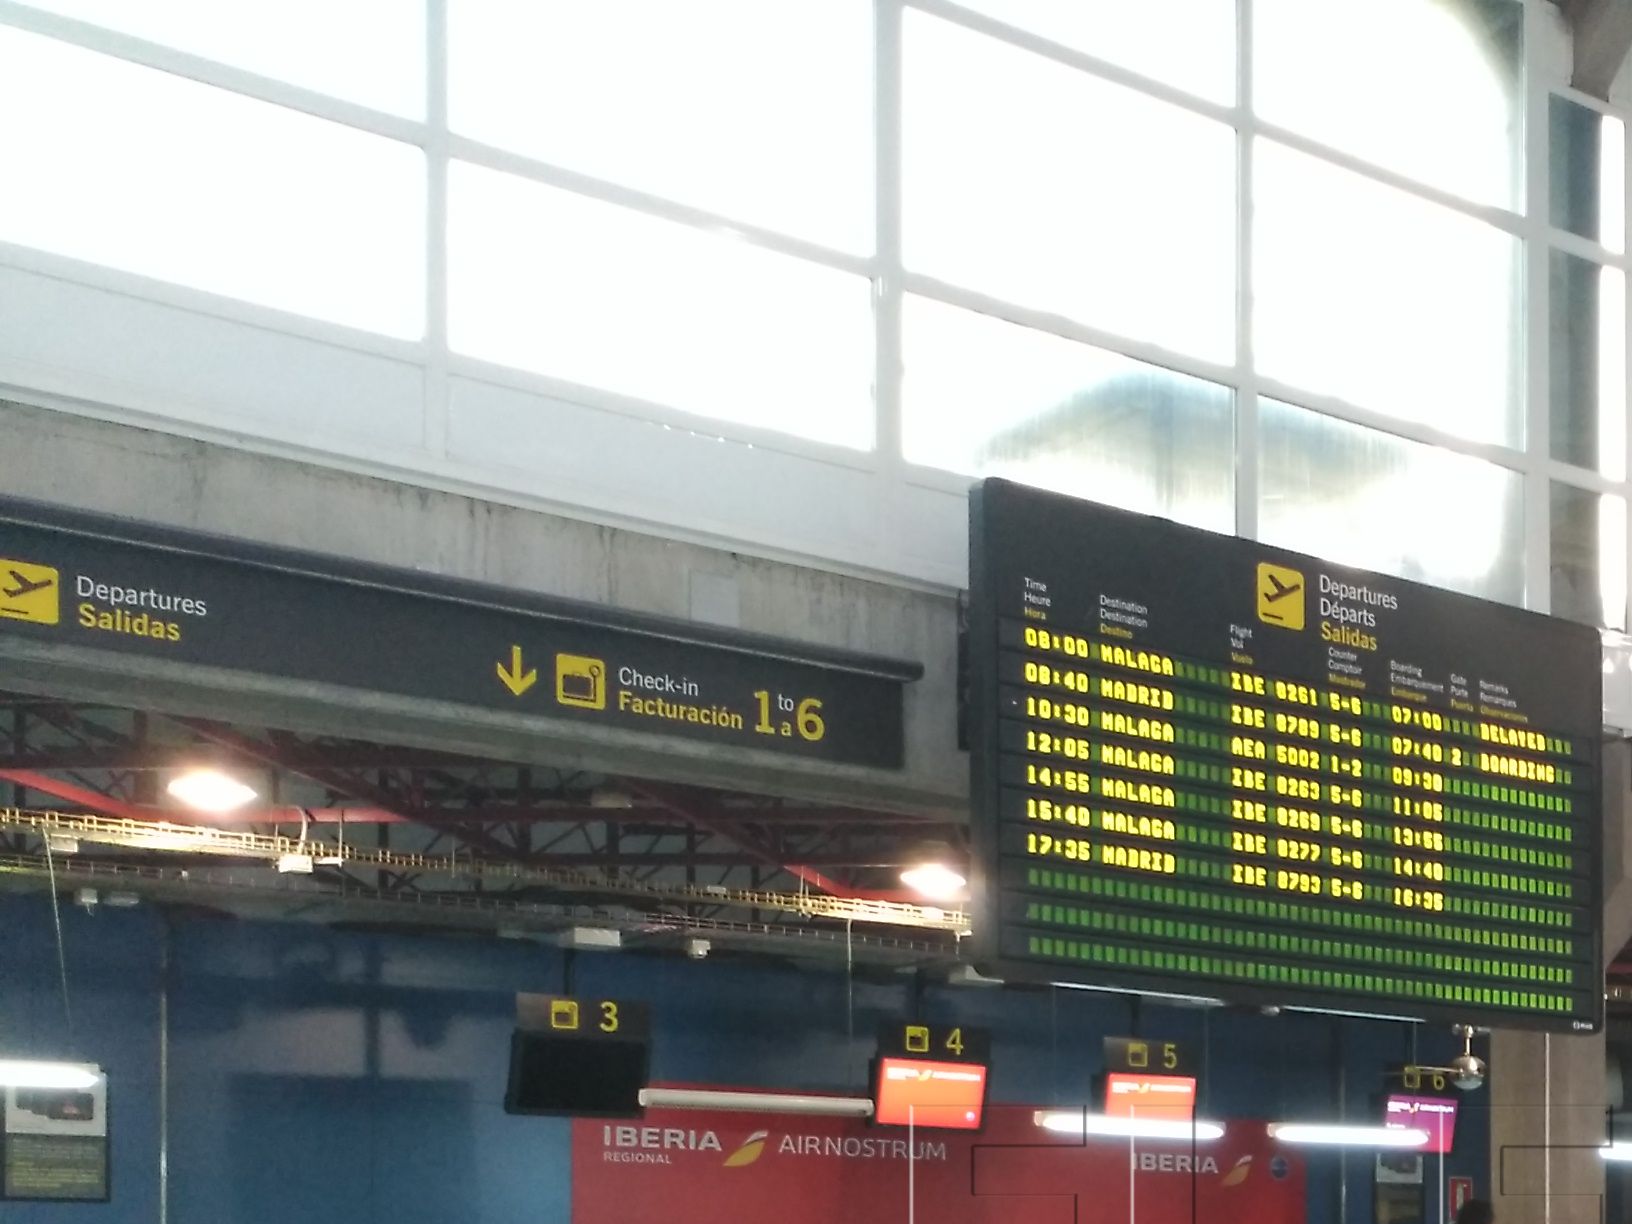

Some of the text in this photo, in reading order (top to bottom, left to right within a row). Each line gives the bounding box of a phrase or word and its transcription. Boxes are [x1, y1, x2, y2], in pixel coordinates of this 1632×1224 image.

[76, 575, 208, 617] Departures
[1024, 577, 1047, 592] Time
[1319, 574, 1398, 611] Departures
[1024, 591, 1051, 607] Heure
[1100, 594, 1148, 615] Destination
[1320, 597, 1376, 627] Départs
[78, 603, 181, 642] Salidas
[1024, 606, 1046, 621] Hora
[1100, 609, 1148, 629] Destination
[1230, 624, 1253, 640] Flight
[1231, 637, 1244, 649] Vol
[1321, 621, 1377, 651] Salidas
[1329, 647, 1357, 662] Counter
[1329, 659, 1363, 676] Comptoir
[618, 666, 699, 697] Check-in
[1391, 660, 1422, 678] Boarding
[1451, 673, 1467, 686] Gate
[1024, 627, 1088, 658] 08:00
[1101, 644, 1174, 677] MALAGA
[1231, 672, 1265, 696] IBE
[1329, 692, 1362, 715] 5-6
[1391, 705, 1443, 731] 07:00
[1480, 723, 1545, 751] DELAYED
[777, 693, 794, 712] to
[619, 690, 825, 742] Facturación 1 6
[781, 721, 792, 737] a
[1024, 662, 1088, 693] 08:40
[1101, 678, 1174, 711] MADRID
[1231, 705, 1265, 728] IBE
[1329, 724, 1362, 747] 5-6
[1391, 736, 1443, 762] 07:40
[1452, 748, 1461, 766] 2
[1481, 753, 1555, 783] BOARDING
[1027, 697, 1443, 792] 10:30 MALAGA AEA 5002 1-2 09:30
[1027, 731, 1089, 760] 12:05
[1102, 744, 1174, 775] MALAGA
[1232, 768, 1266, 791] IBE
[1330, 785, 1362, 808] 5-6
[1393, 797, 1443, 822] 11:05
[1028, 765, 1090, 794] 14:55
[1102, 777, 1175, 808] MALAGA
[1232, 799, 1266, 823] IBE
[1330, 816, 1363, 839] 5-6
[1394, 826, 1443, 851] 13:55
[1028, 799, 1090, 827] 15:40
[1102, 811, 1175, 840] MALAGA
[1232, 831, 1266, 854] IBE
[1330, 847, 1363, 869] 5-6
[1394, 857, 1443, 881] 14:40
[1028, 834, 1090, 861] 17:35
[1102, 845, 1176, 874] MADRID
[1232, 864, 1266, 887] IBE
[1330, 878, 1363, 900] 5-6
[1394, 887, 1444, 912] 16:35
[600, 1001, 619, 1033] 3
[946, 1028, 964, 1055] 4
[1164, 1043, 1177, 1069] 5
[1433, 1068, 1445, 1090] 6
[603, 1125, 722, 1151] IBERIA
[603, 1151, 673, 1166] REGIONAL
[1132, 1152, 1219, 1174] IBERIA
